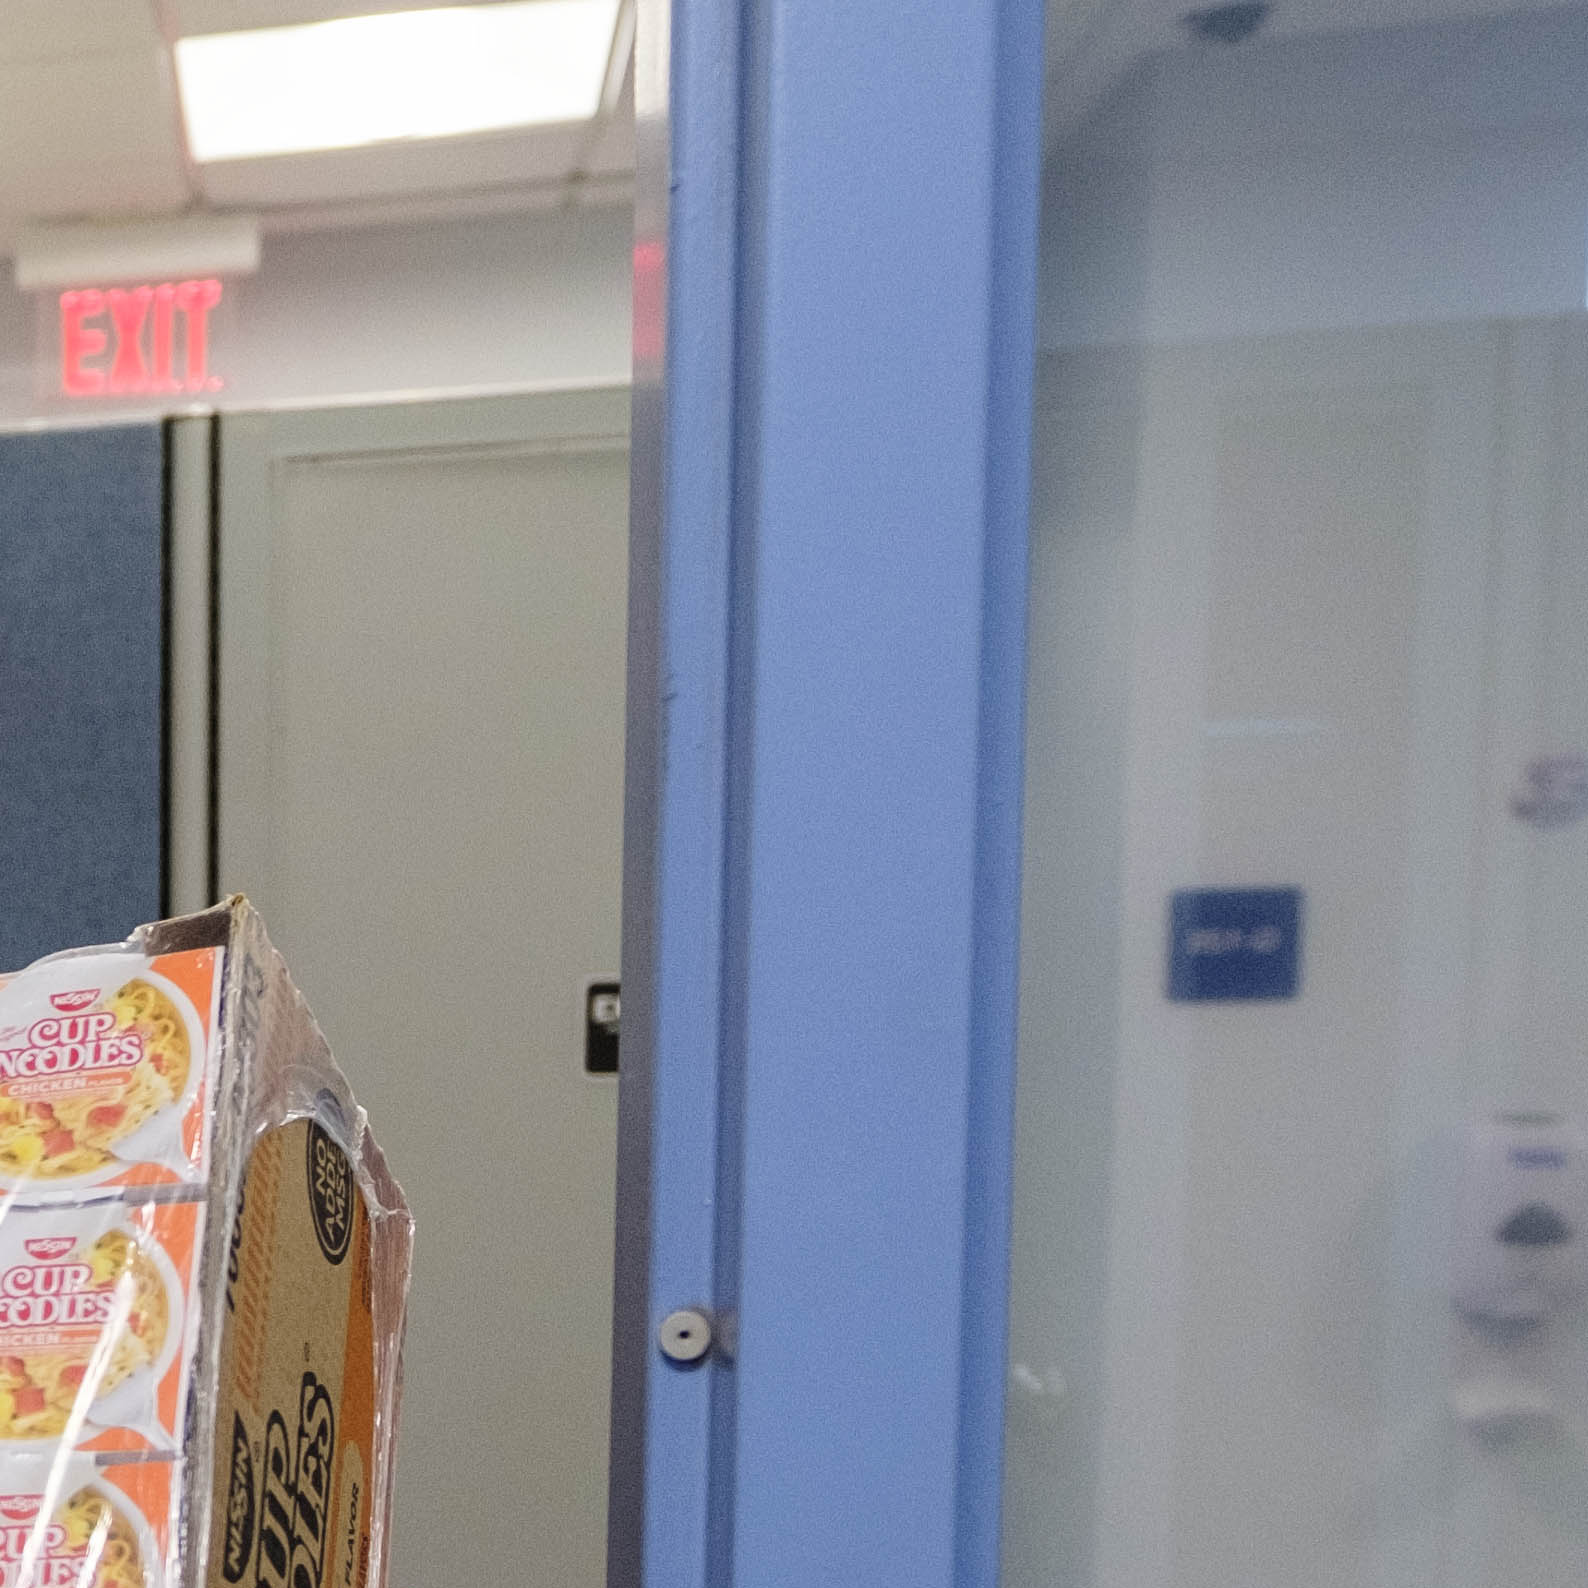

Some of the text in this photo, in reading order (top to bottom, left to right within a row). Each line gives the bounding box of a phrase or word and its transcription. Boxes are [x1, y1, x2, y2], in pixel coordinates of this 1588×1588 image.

[60, 280, 222, 396] EXIT
[28, 1012, 116, 1047] CUP
[8, 1077, 86, 1096] CHICKEN
[315, 1137, 327, 1196] NO
[324, 1143, 338, 1244] ADDE
[2, 1264, 92, 1296] CUP
[226, 1435, 252, 1577] NISSIN
[345, 1482, 361, 1587] FLAVOR
